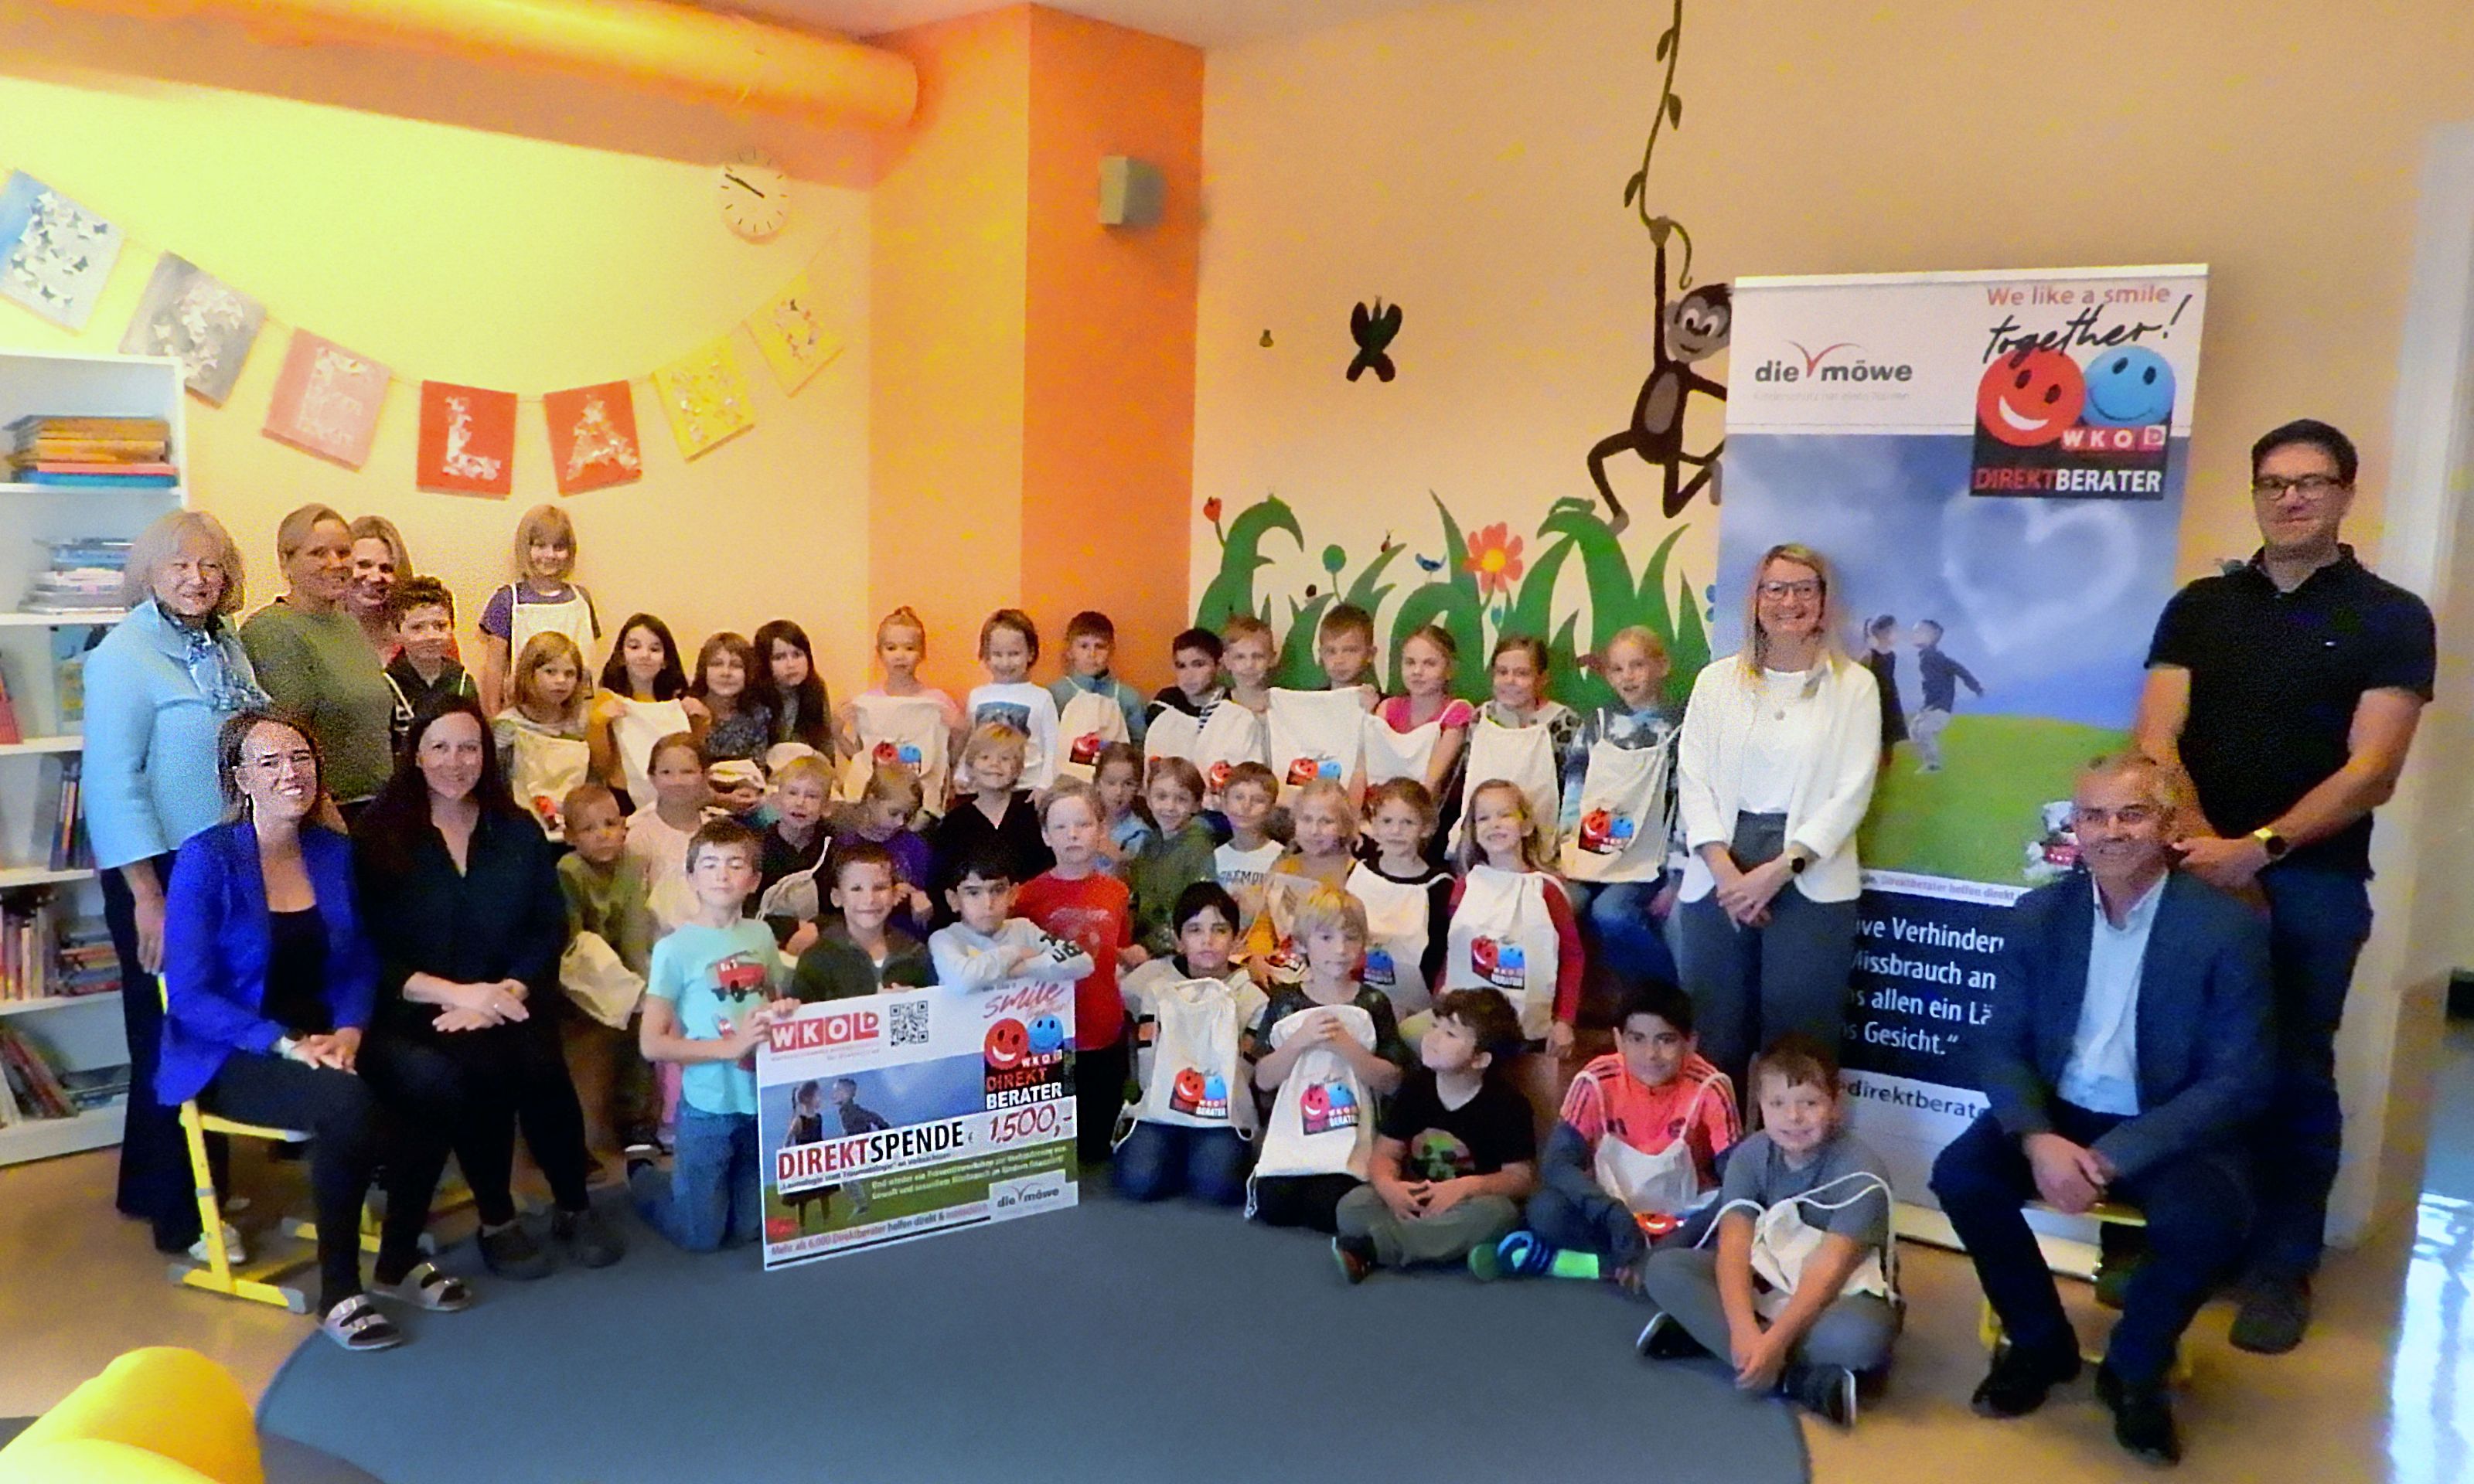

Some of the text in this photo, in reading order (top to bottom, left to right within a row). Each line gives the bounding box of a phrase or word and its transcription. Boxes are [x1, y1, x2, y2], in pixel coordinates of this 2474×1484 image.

[1987, 285, 2170, 306] We like a smile
[1982, 294, 2193, 369] together!
[1755, 359, 1912, 382] die möwe
[1968, 971, 1996, 990] an
[1871, 988, 1923, 1016] allen
[1930, 998, 1961, 1021] ein
[987, 1068, 1048, 1092] DIREKT
[987, 1082, 1062, 1110] BERATER
[779, 1122, 963, 1180] DIREKTSPENDE
[997, 1196, 1015, 1207] die
[888, 1219, 912, 1230] helfen
[913, 1213, 936, 1225] direkt
